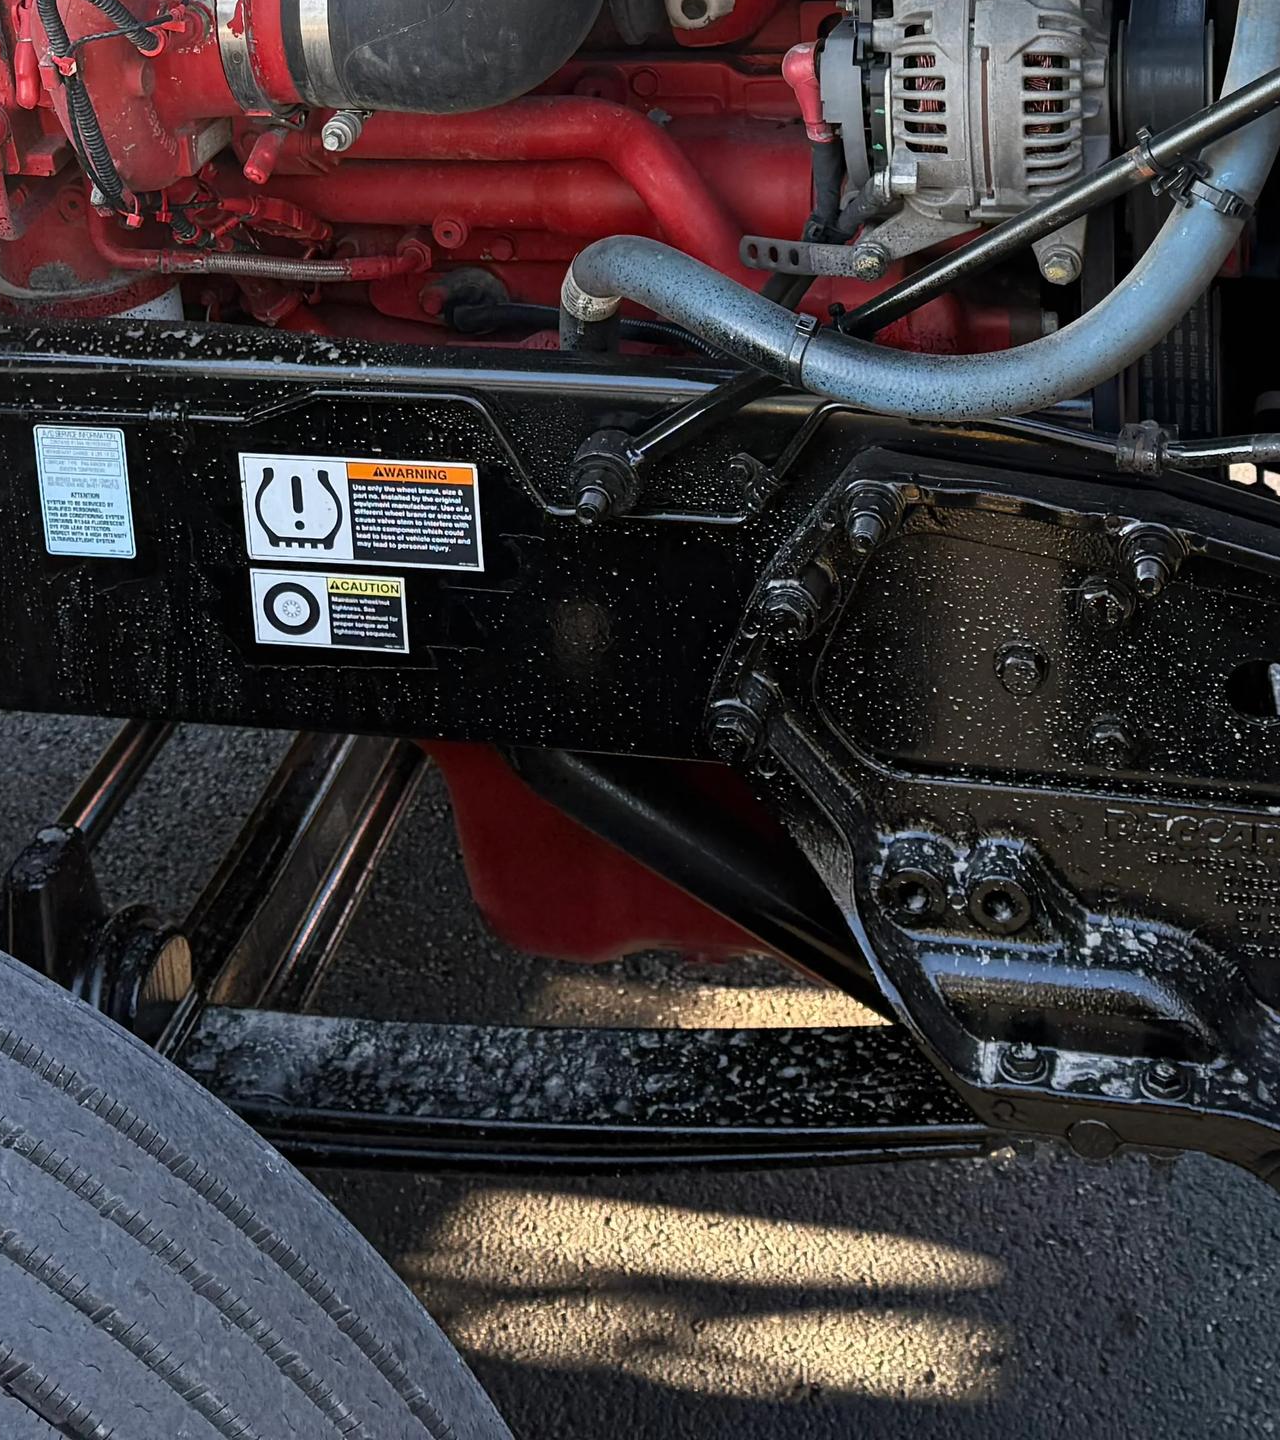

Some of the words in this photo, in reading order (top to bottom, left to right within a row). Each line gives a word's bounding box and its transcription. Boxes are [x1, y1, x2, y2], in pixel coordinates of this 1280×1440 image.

[383, 466, 447, 480] WARNING
[367, 485, 382, 493] only
[412, 495, 420, 503] by
[434, 496, 462, 505] original
[441, 504, 455, 512] Use
[354, 508, 384, 516] different
[384, 509, 405, 517] wheel
[452, 513, 472, 521] could
[361, 524, 381, 532] brake
[382, 526, 421, 534] component
[454, 521, 470, 529] with
[429, 544, 451, 553] injury.
[341, 581, 399, 594] CAUTION
